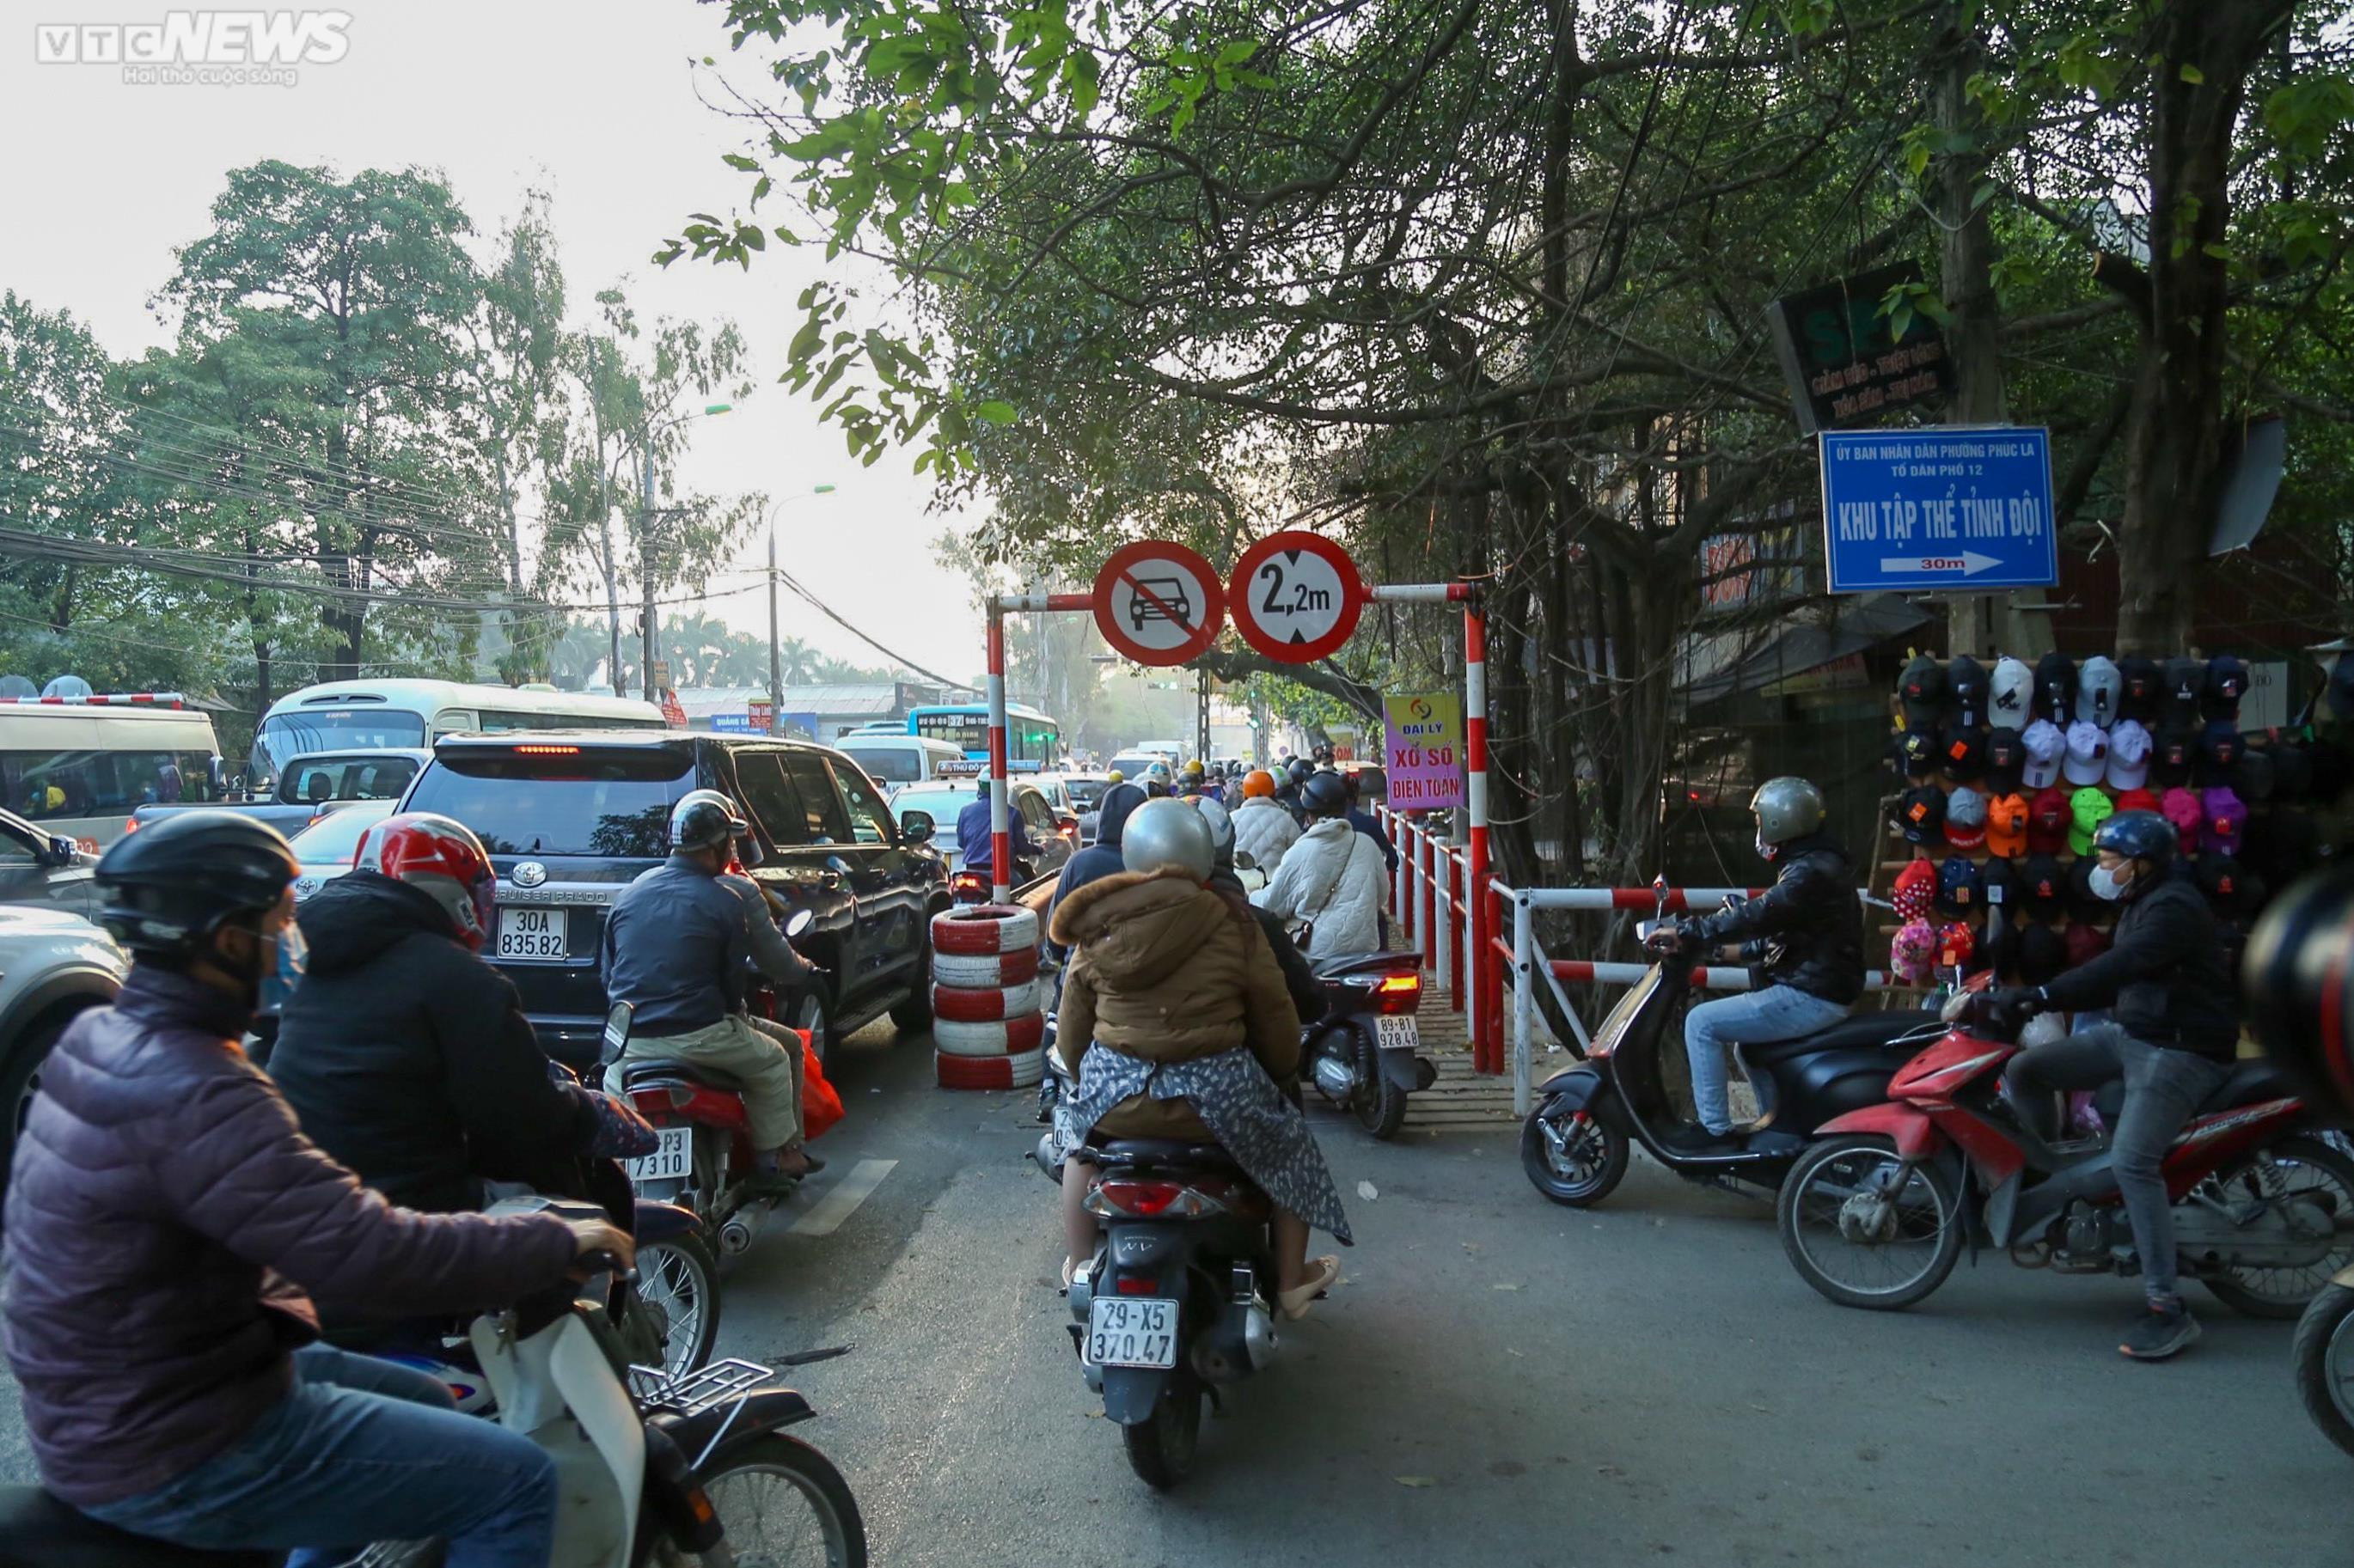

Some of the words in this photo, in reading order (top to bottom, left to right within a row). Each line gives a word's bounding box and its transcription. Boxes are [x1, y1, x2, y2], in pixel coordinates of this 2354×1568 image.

[1837, 443, 1850, 461] ỦY
[1854, 447, 1877, 461] BAN
[1880, 443, 1911, 460] NHÂN
[1915, 442, 1937, 459] DÂN
[1941, 442, 1985, 458] PHƯỜNG
[1989, 442, 2018, 457] PHÚC
[2021, 443, 2034, 456] LA
[1911, 463, 1935, 477] DÂN
[1940, 461, 1964, 476] PHỐ
[1968, 464, 1983, 475] 12
[1838, 501, 1877, 540] KHU
[1881, 492, 1917, 548] TẬP
[1922, 484, 1957, 539] THỂ
[1960, 486, 2005, 537] TỈNH
[2009, 490, 2041, 545] ĐỘI
[1921, 558, 1966, 569] 30m
[1261, 564, 1330, 616] 2,2m
[1403, 724, 1424, 736] ĐẠI
[1428, 722, 1442, 734] LÝ
[1395, 741, 1421, 768] XỔ
[1428, 741, 1453, 766] SỐ
[1393, 777, 1422, 802] ĐIỆN
[1426, 775, 1458, 796] TOÁN
[556, 892, 607, 901] PRADO
[517, 912, 549, 933] 30A
[502, 934, 561, 956] 835.82
[1379, 1032, 1417, 1046] 928.48
[636, 1154, 682, 1177] 7310
[1103, 1303, 1165, 1331] 29-X5
[1094, 1333, 1170, 1364] 370.47
